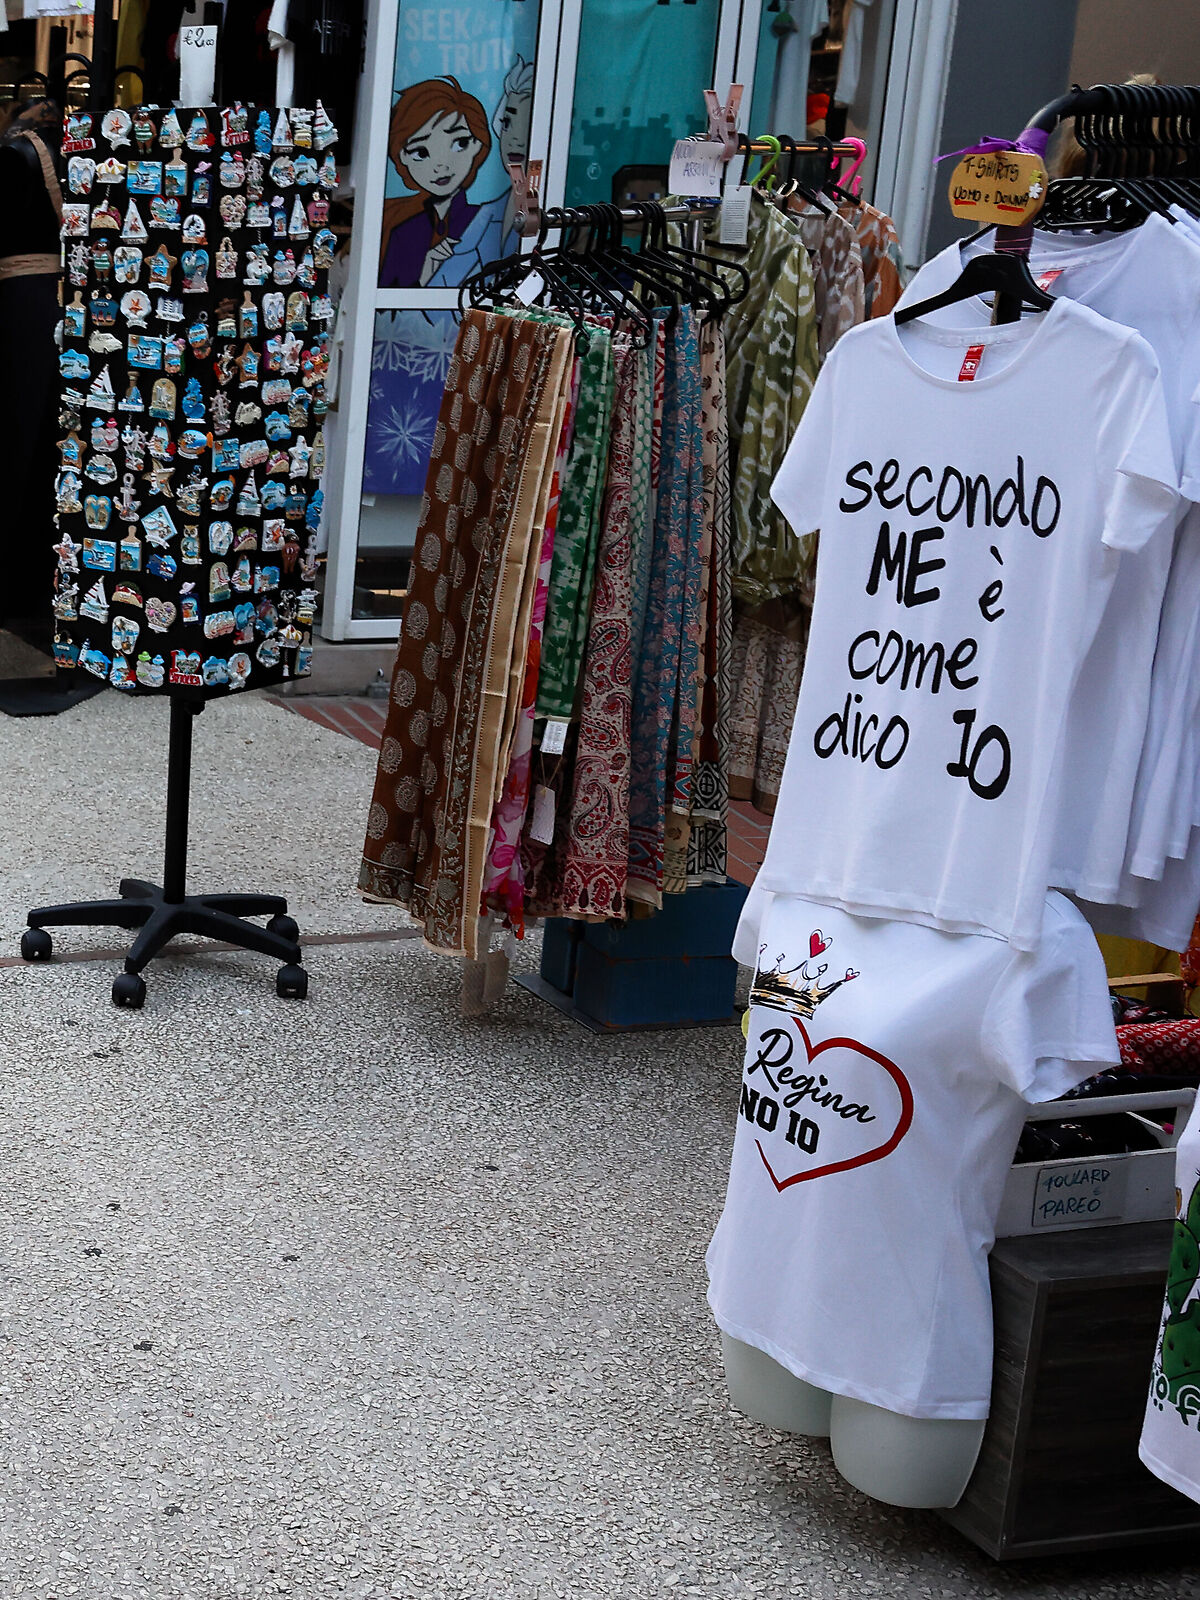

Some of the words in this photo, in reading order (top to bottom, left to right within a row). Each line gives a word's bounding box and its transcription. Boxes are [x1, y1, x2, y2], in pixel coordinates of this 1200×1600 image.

[405, 8, 471, 41] SEEK
[963, 156, 1019, 182] T-SHIRTS
[839, 455, 1061, 538] secondo
[865, 521, 946, 608] ME
[978, 545, 1005, 622] è
[848, 630, 979, 693] come
[813, 693, 909, 769] dico
[946, 708, 1012, 800] IO
[747, 1028, 877, 1124] Regina
[785, 1109, 820, 1155] IO
[1039, 1196, 1102, 1219] PAREO
